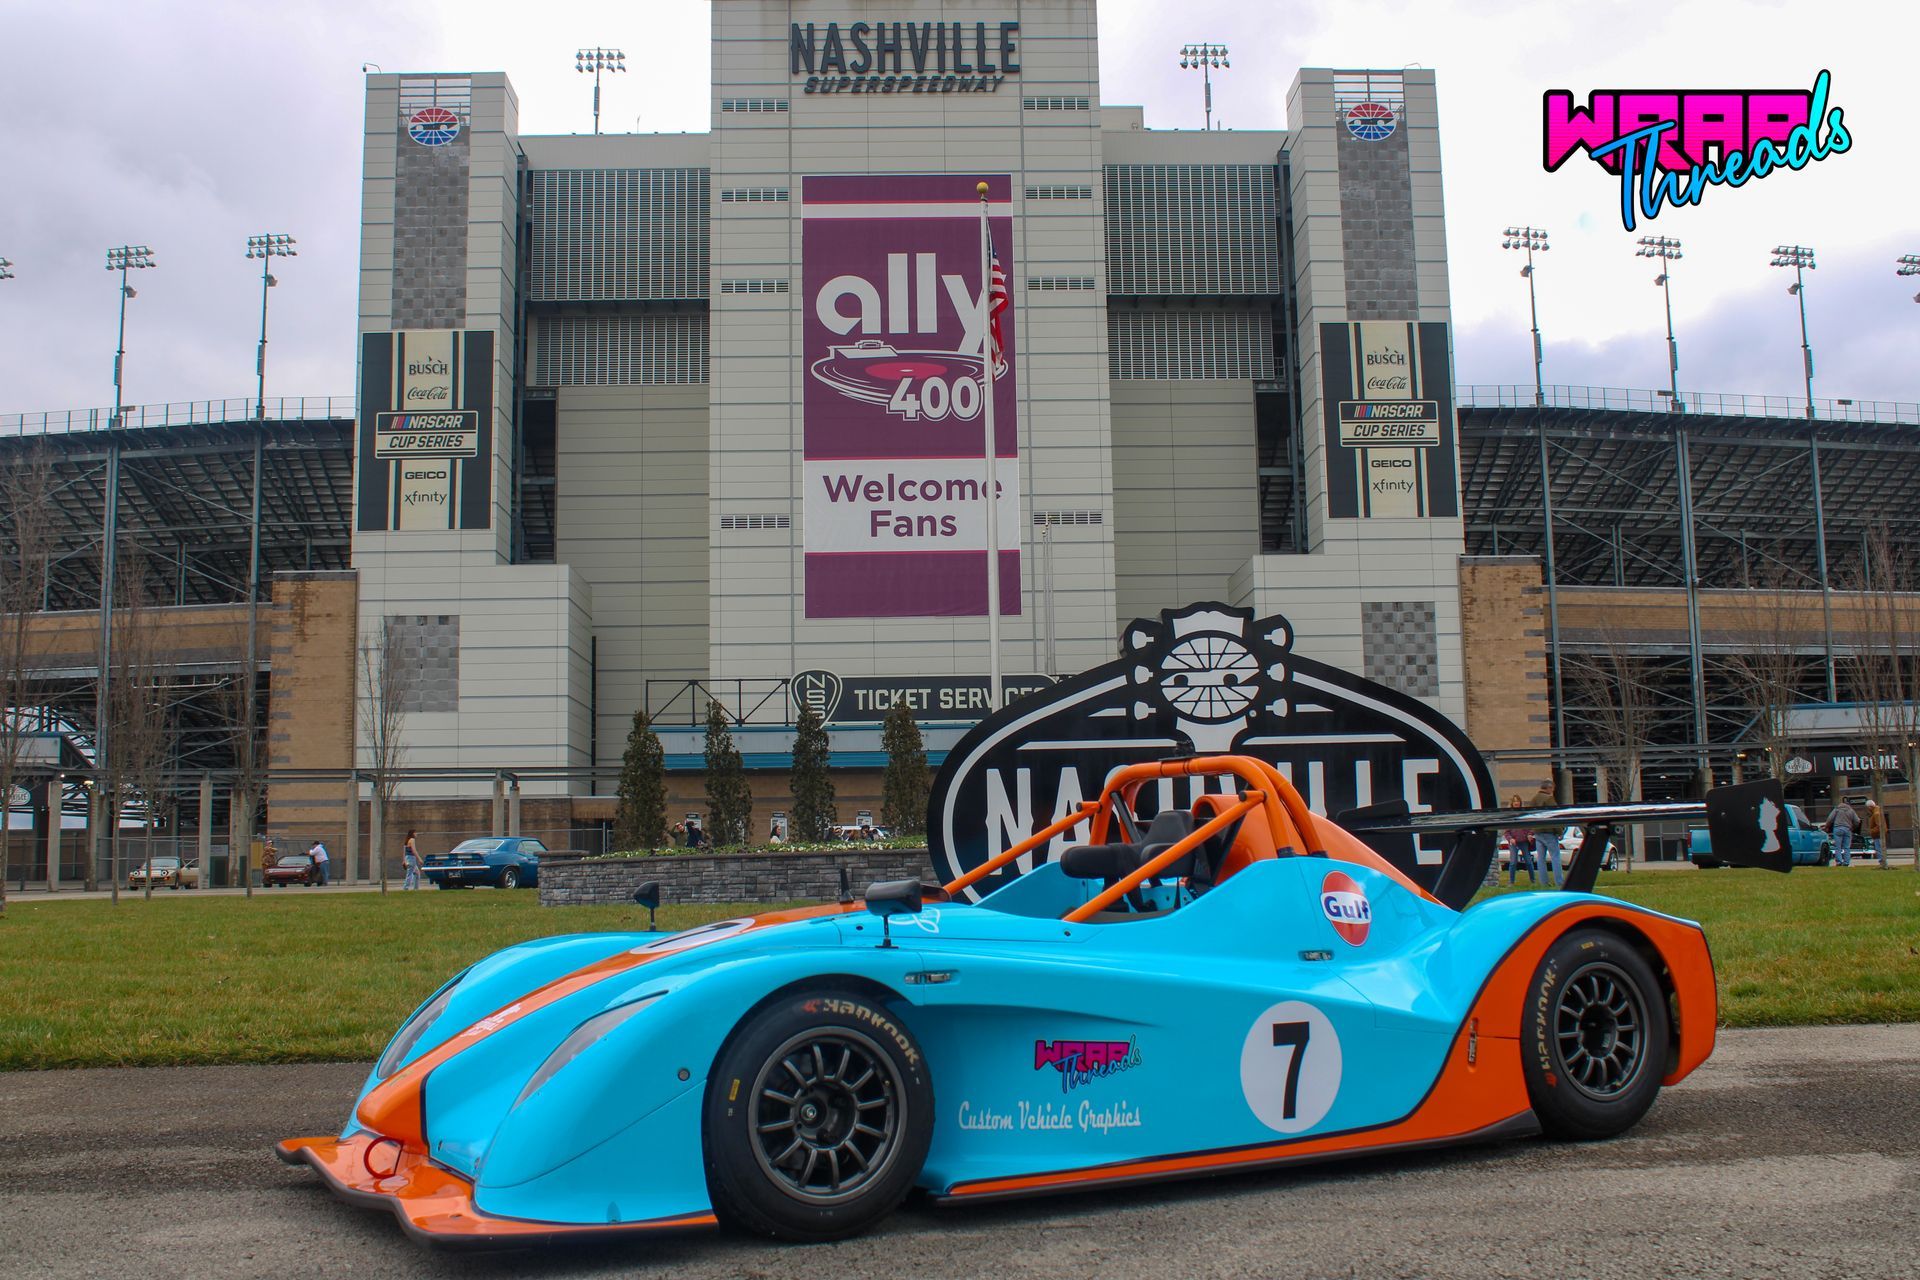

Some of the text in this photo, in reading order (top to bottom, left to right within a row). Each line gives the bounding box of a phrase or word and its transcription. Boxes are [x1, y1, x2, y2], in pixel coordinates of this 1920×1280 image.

[791, 22, 1020, 74] NASHVILLE
[803, 75, 1006, 94] SUPERSPEEDWAY
[816, 253, 1007, 355] ally
[408, 361, 449, 376] BUSCH
[1366, 352, 1405, 366] BUSCH
[889, 376, 981, 419] 400
[1371, 405, 1423, 418] NASCAR
[408, 415, 463, 429] NASCAR
[1353, 424, 1426, 437] CUP SERIES
[389, 435, 464, 448] CUP SERIES
[1371, 459, 1412, 468] GEICO
[404, 471, 447, 480] GEICO
[1372, 478, 1414, 493] xfinity
[404, 490, 448, 506] xfinity
[870, 509, 958, 538] Fans
[854, 688, 932, 710] TICKET
[1323, 896, 1370, 921] Gulf
[1034, 1039, 1132, 1072] WRAP
[1052, 1034, 1143, 1094] Threads
[1272, 1021, 1310, 1121] 7
[958, 1100, 1142, 1135] Custom Vehicle Graphics
